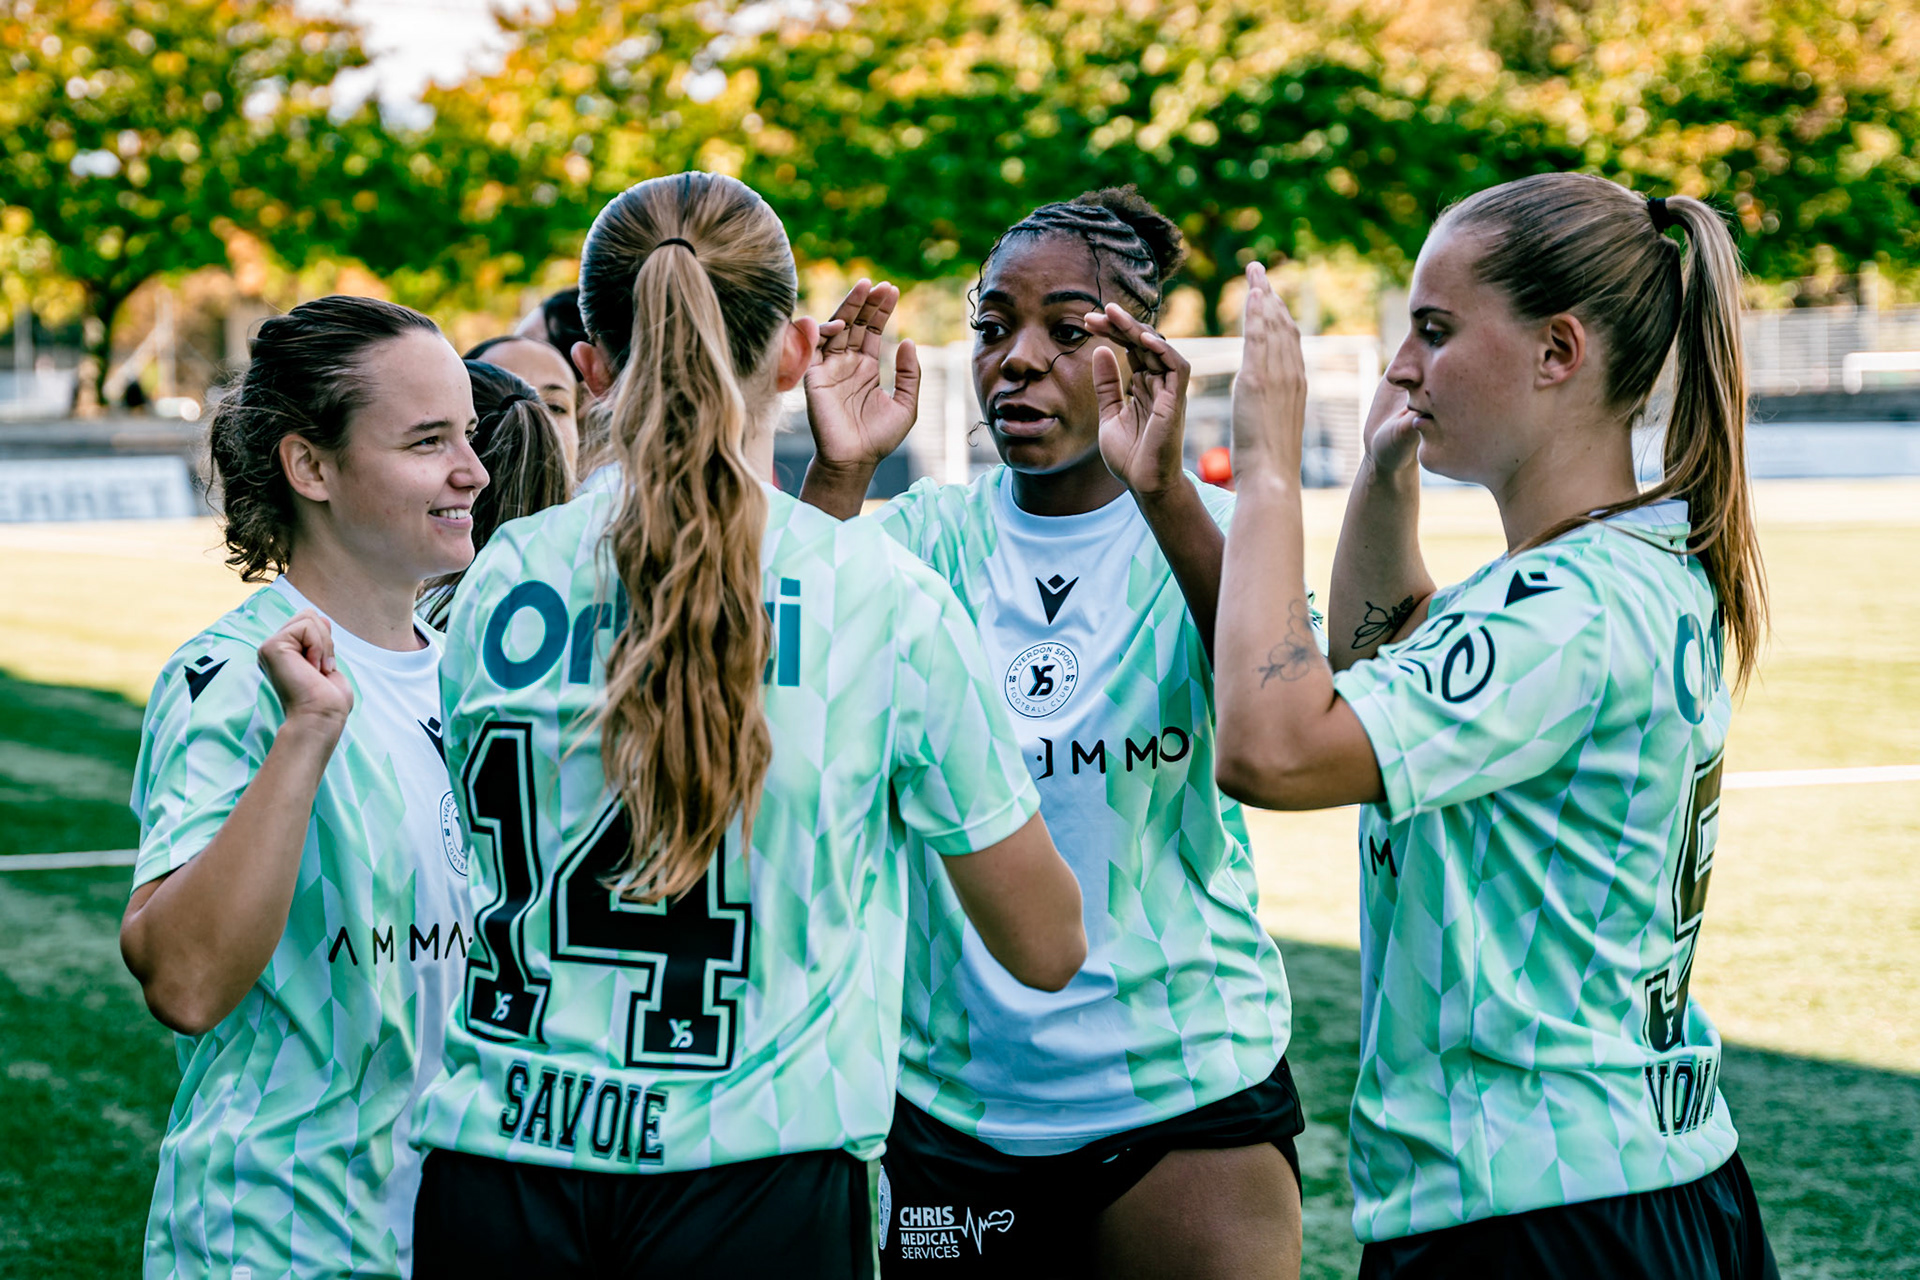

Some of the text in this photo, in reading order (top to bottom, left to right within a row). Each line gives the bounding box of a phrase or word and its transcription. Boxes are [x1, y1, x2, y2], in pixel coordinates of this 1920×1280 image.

[1012, 646, 1075, 673] YVERDON SPORT
[1065, 674, 1076, 682] 97
[1010, 685, 1070, 713] FOOTBALL CLUB
[462, 721, 752, 1072] 14
[498, 1060, 669, 1166] SAVOIE
[900, 1205, 955, 1227] CHRIS
[901, 1231, 958, 1246] MEDICAL
[902, 1245, 960, 1259] SERVICES
